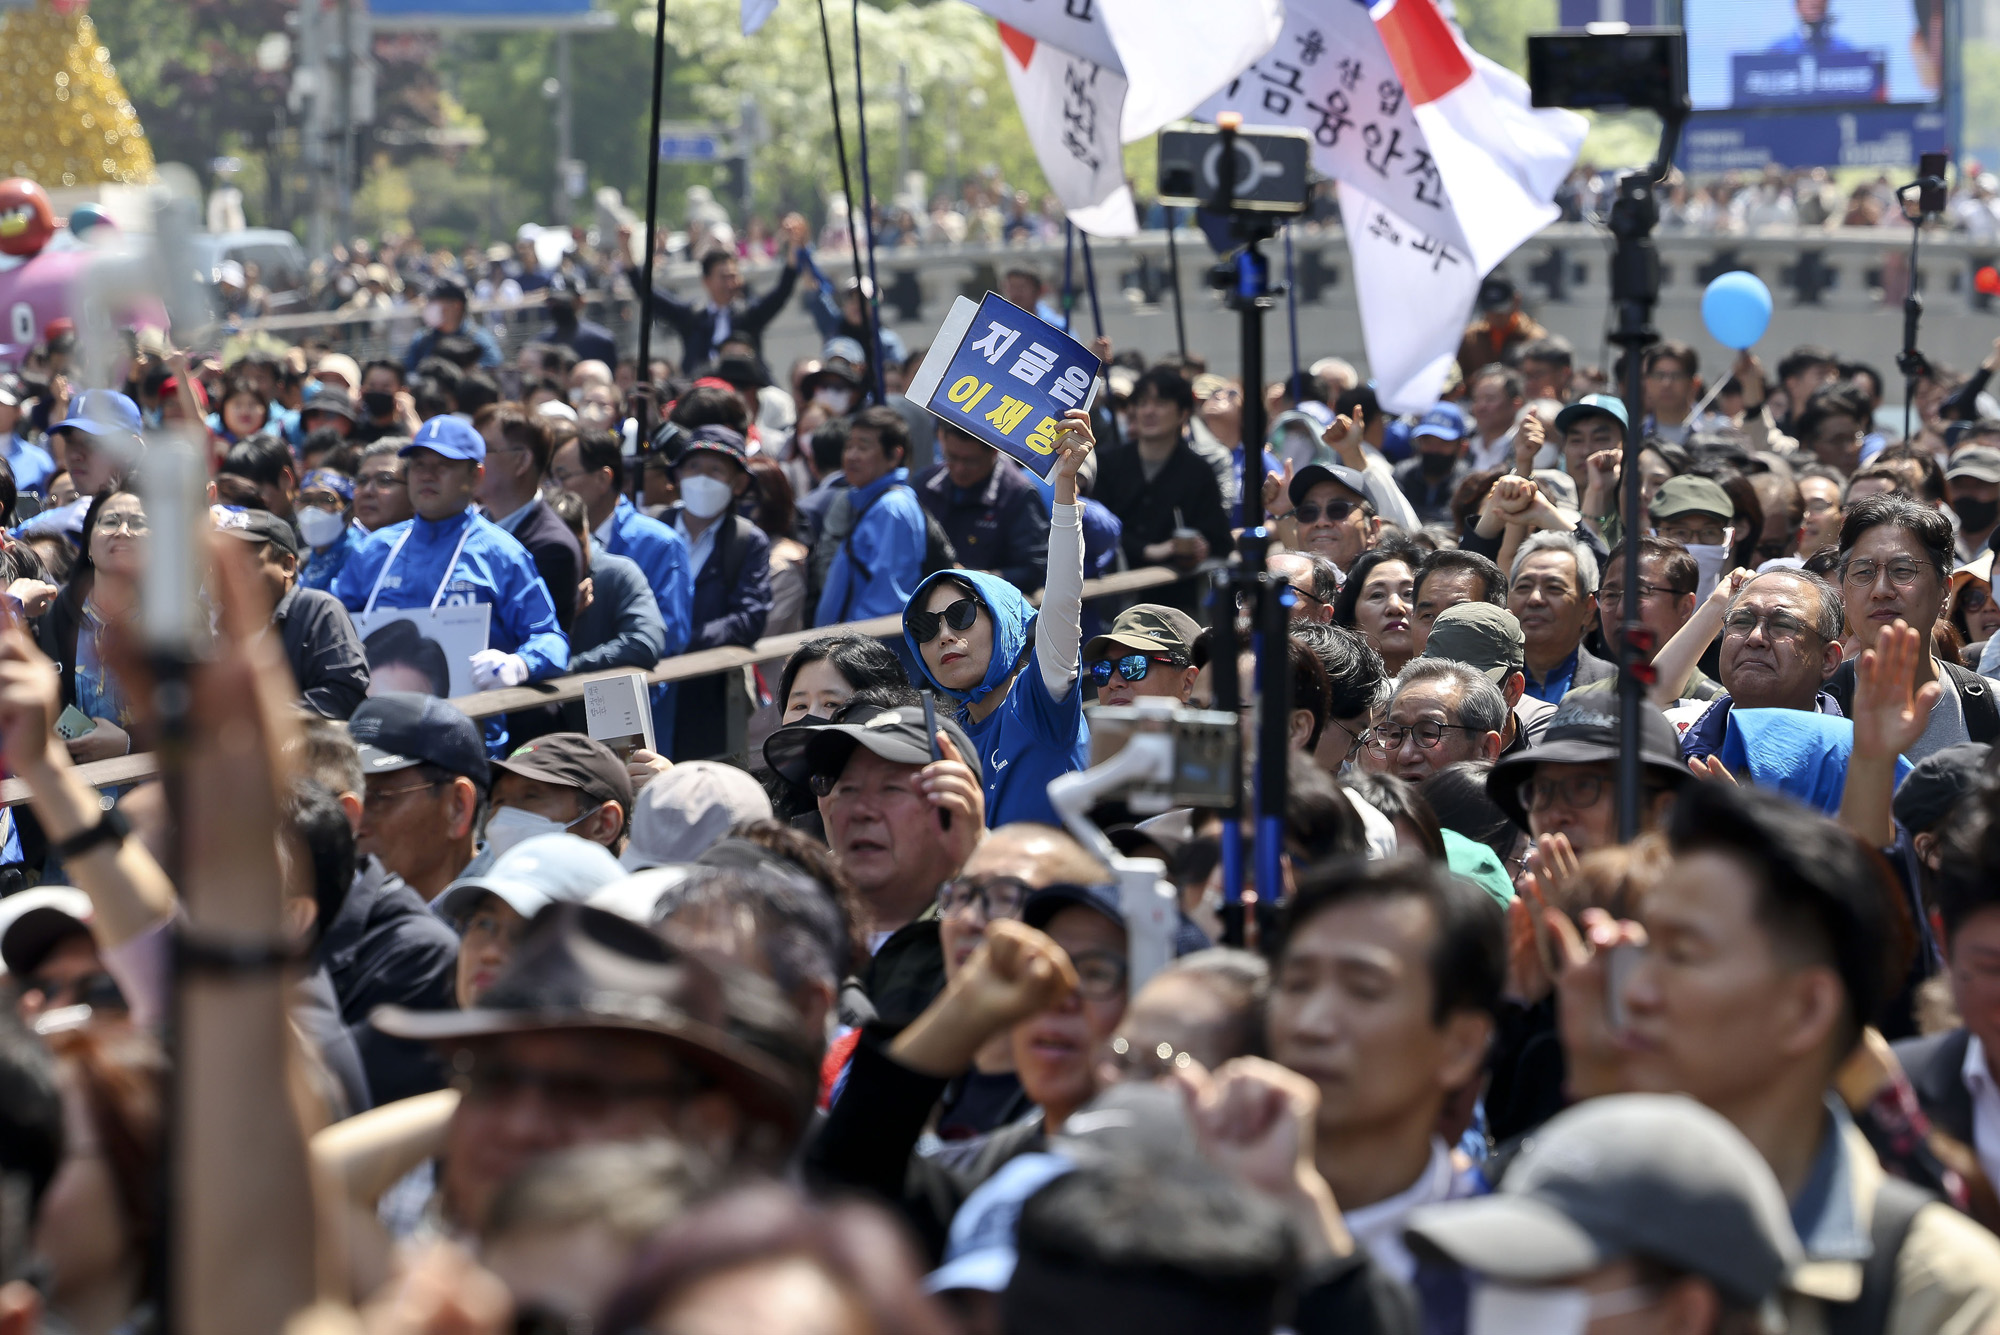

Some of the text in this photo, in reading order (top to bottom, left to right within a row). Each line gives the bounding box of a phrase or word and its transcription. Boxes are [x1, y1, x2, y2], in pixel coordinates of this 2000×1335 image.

[971, 320, 1090, 408] 지금은
[429, 419, 441, 438] 1
[946, 374, 1073, 456] 이재명
